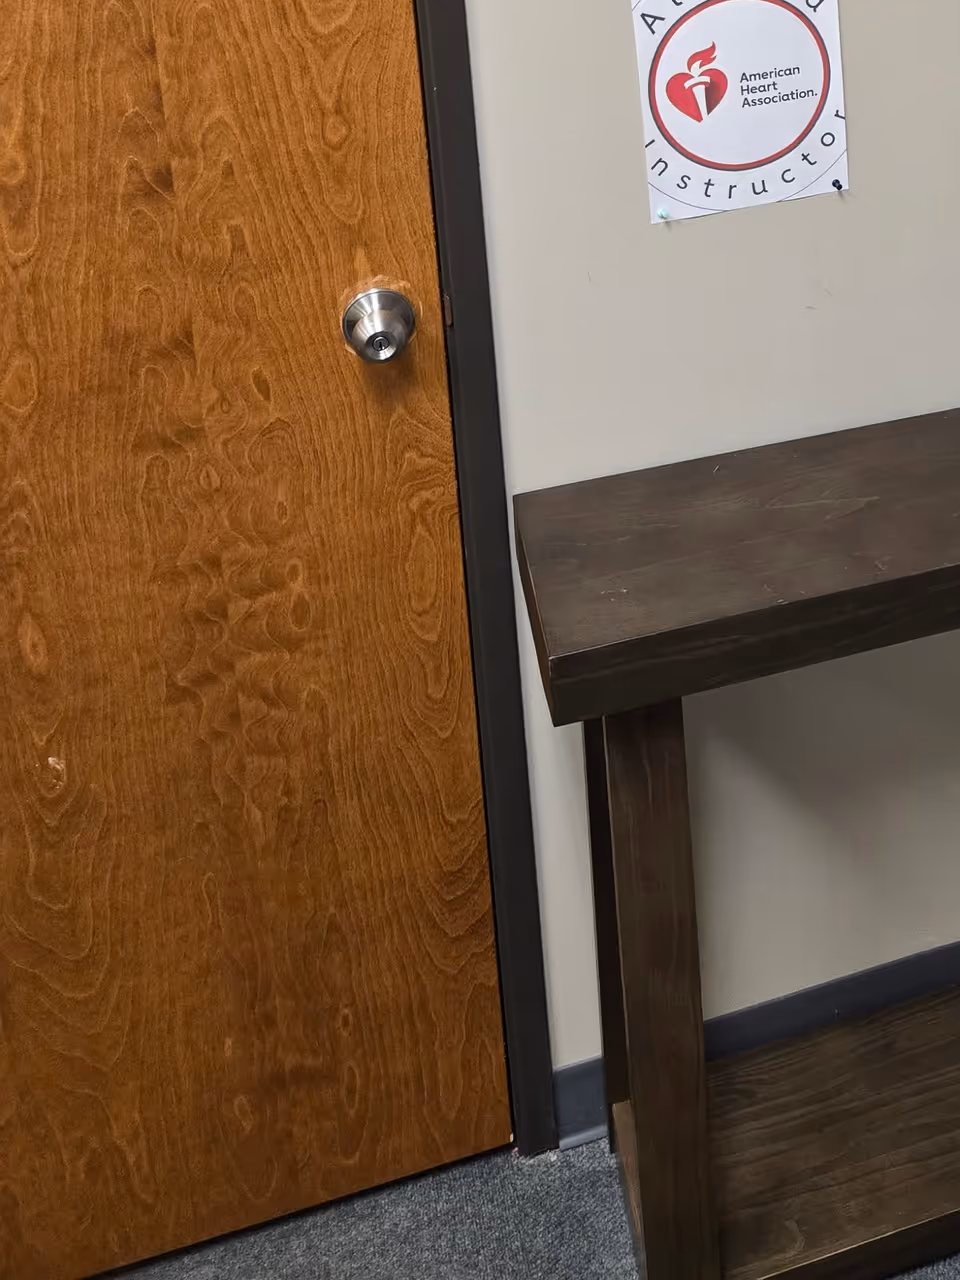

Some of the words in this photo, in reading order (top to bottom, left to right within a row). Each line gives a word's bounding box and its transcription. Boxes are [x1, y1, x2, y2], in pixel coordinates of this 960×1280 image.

[740, 66, 800, 83] American
[740, 80, 778, 95] Heart
[742, 87, 818, 108] Association.
